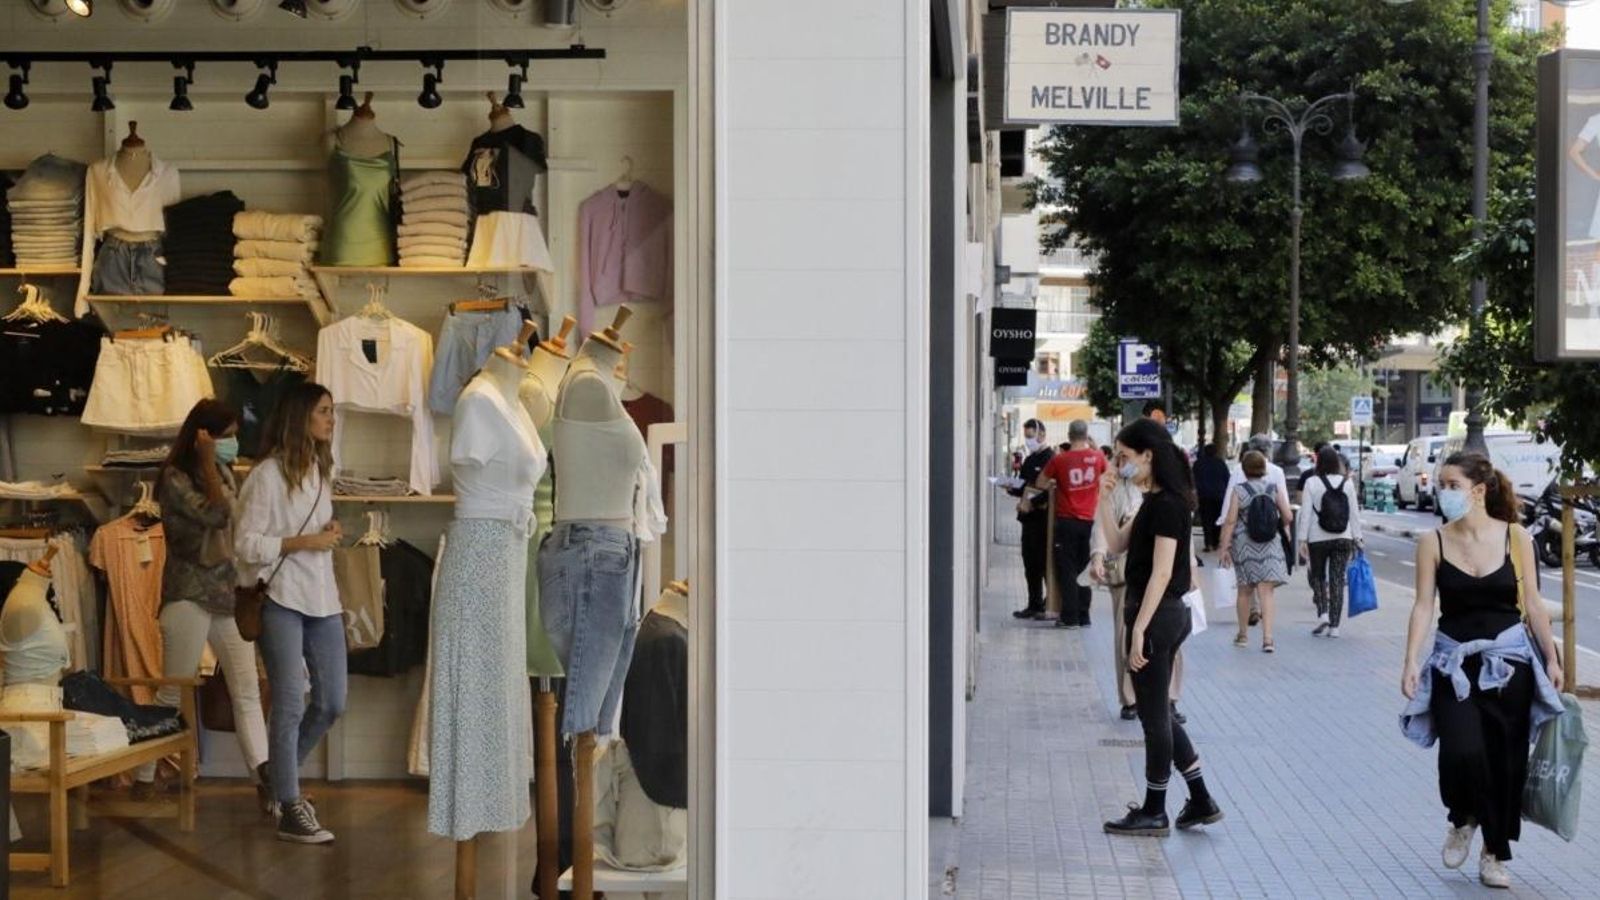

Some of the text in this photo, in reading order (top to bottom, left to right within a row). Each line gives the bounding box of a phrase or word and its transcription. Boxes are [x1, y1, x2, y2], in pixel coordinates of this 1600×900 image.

[1045, 22, 1140, 47] BRANDY
[1031, 86, 1152, 110] MELVILLE
[993, 328, 1033, 339] OYSHO
[1122, 344, 1153, 372] P
[998, 366, 1027, 375] OYSHO
[1069, 466, 1096, 486] 04
